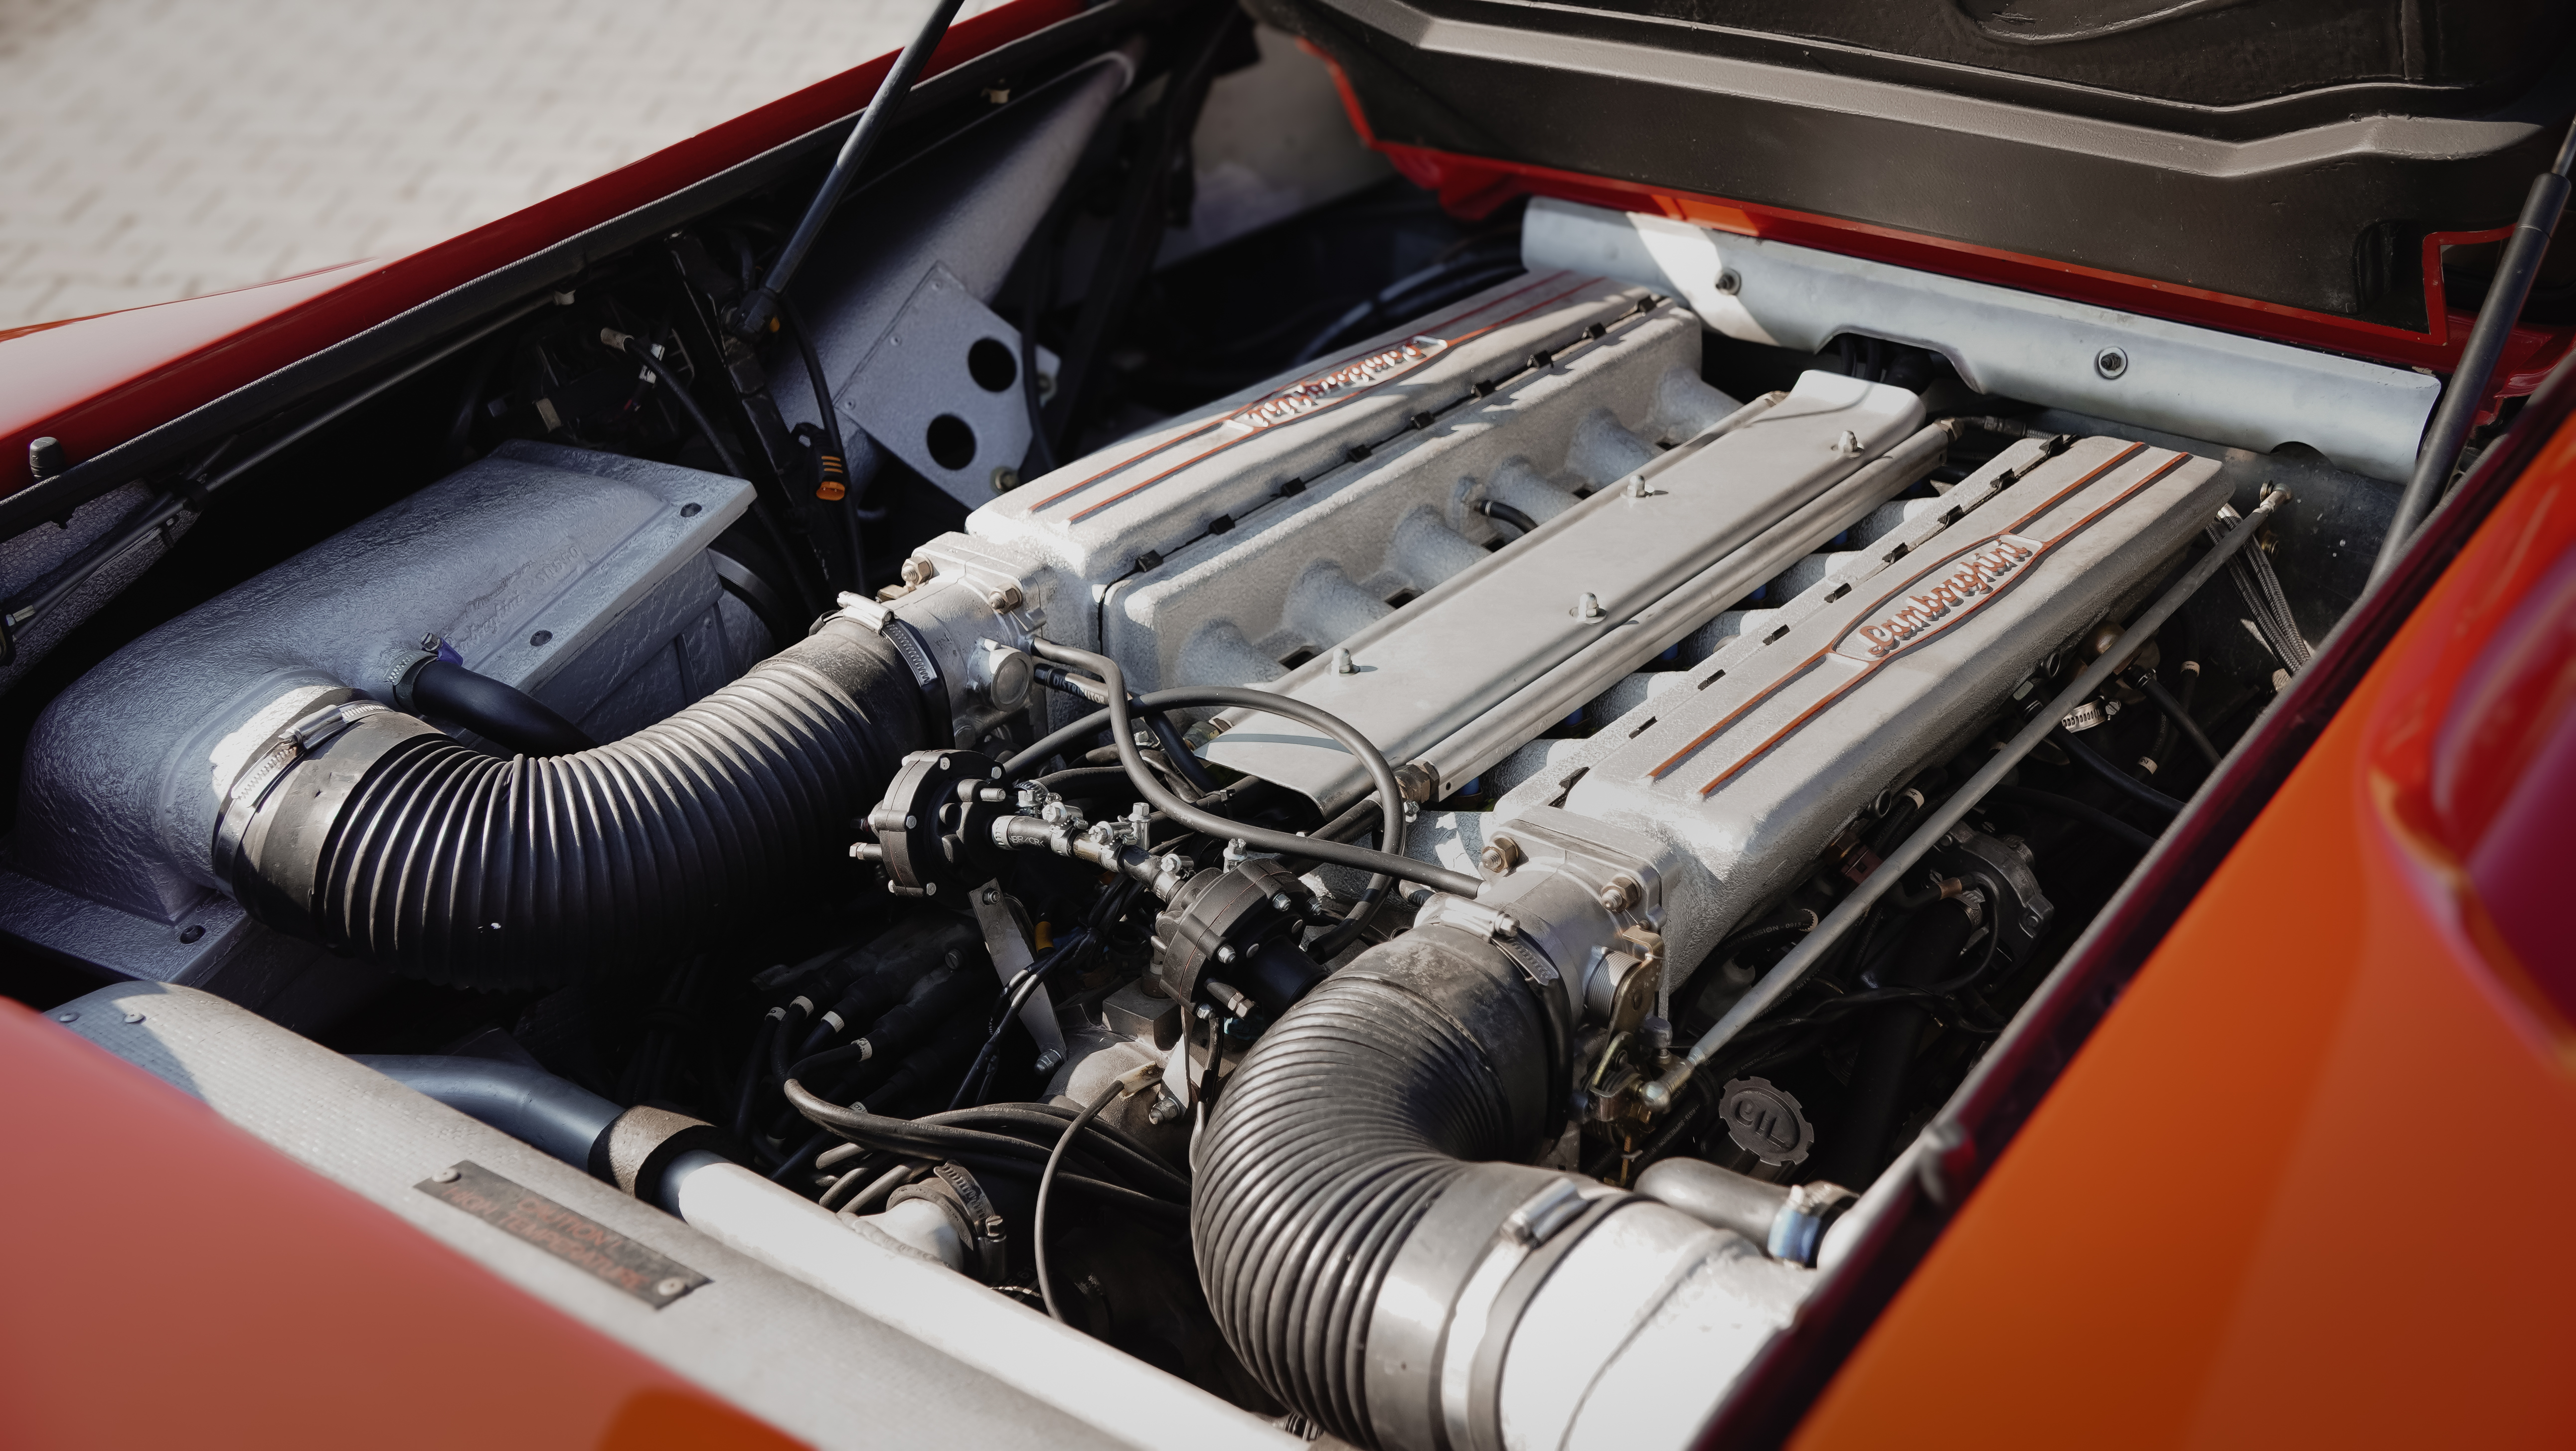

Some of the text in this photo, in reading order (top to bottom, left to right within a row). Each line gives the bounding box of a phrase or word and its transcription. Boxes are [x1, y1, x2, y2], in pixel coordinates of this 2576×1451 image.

[1859, 539, 2029, 656] Lamborghini
[1872, 805, 1906, 847] SUPPRESSION
[1724, 925, 1779, 951] SUPPRESSION
[1750, 992, 1792, 1022] UPPRESSION
[919, 1123, 943, 1134] RISTS
[1734, 1099, 1788, 1149] OIL
